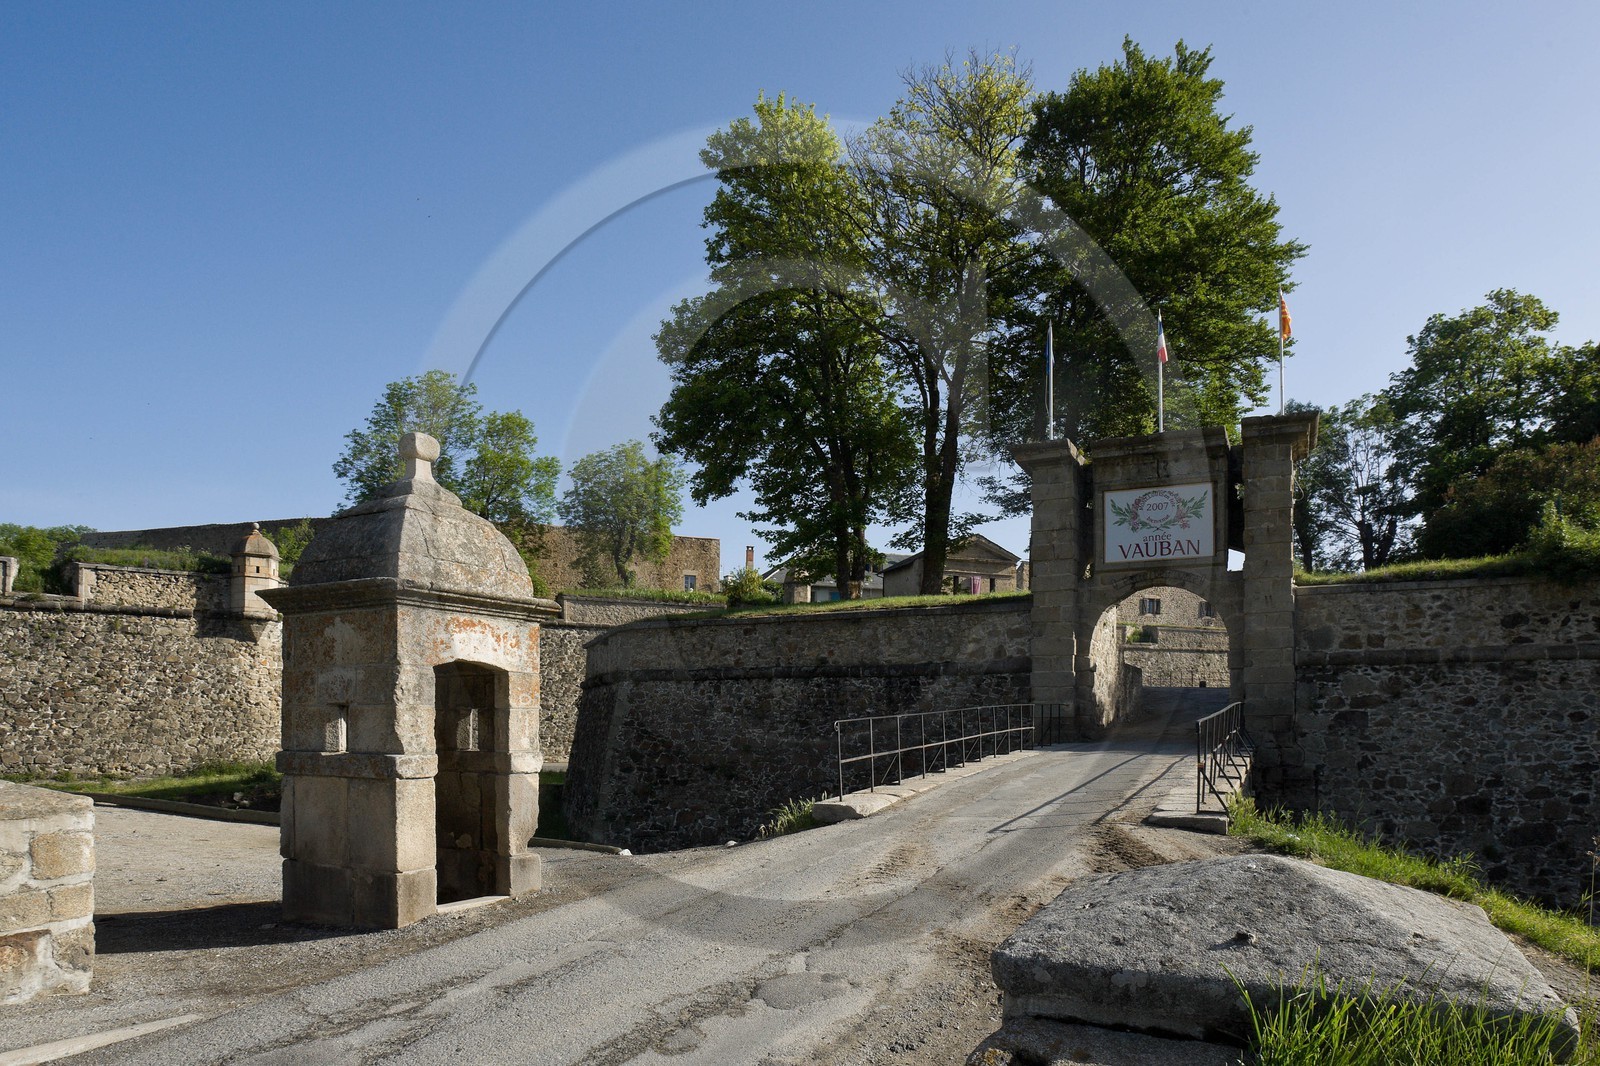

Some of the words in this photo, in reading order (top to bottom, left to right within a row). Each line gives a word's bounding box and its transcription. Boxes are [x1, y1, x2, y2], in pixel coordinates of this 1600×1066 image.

[1146, 502, 1169, 511] 2007
[1143, 532, 1172, 542] année
[1118, 539, 1200, 559] VAUBAN
